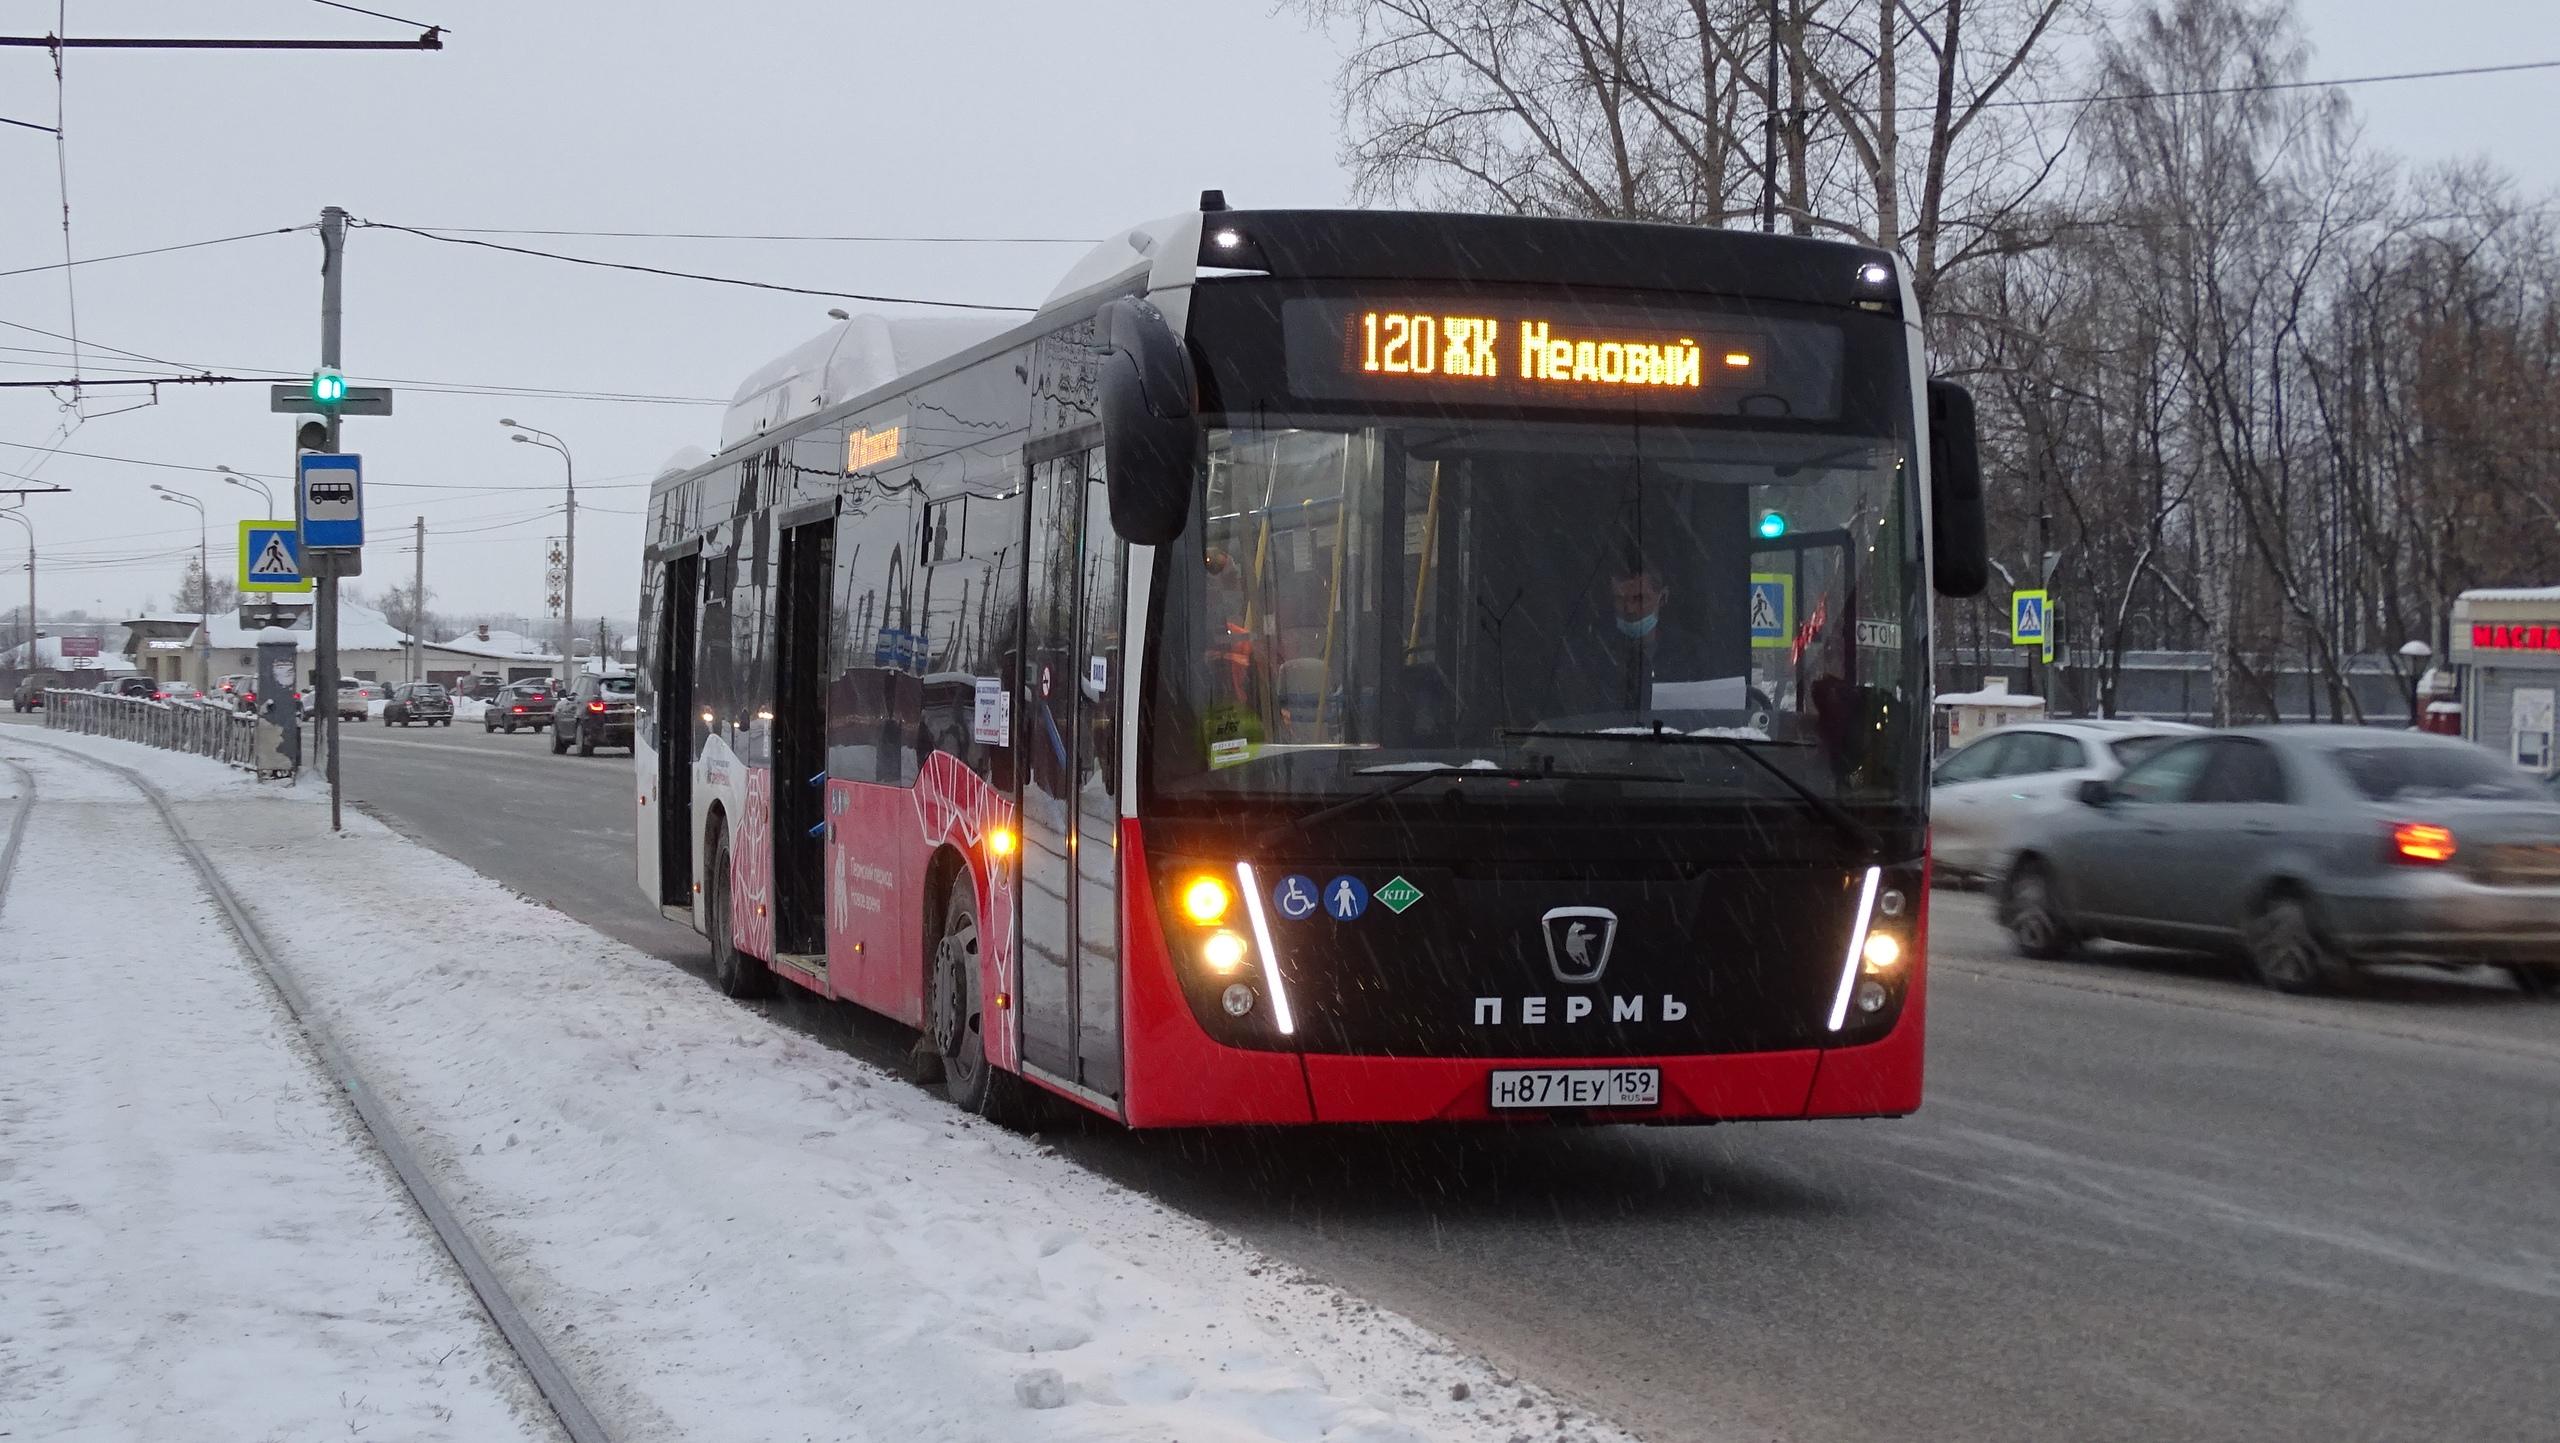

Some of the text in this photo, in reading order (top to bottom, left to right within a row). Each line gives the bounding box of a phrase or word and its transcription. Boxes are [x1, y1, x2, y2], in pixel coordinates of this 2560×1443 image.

[1362, 312, 1436, 374] 120
[1443, 316, 1498, 378] ЖК
[1520, 320, 1701, 388] Недовый
[1383, 888, 1415, 901] КПГ
[1474, 994, 1688, 1026] ПЕРМЬ
[1500, 1071, 1651, 1103] Н871ЕУ 159
[1620, 1094, 1641, 1102] RUS
